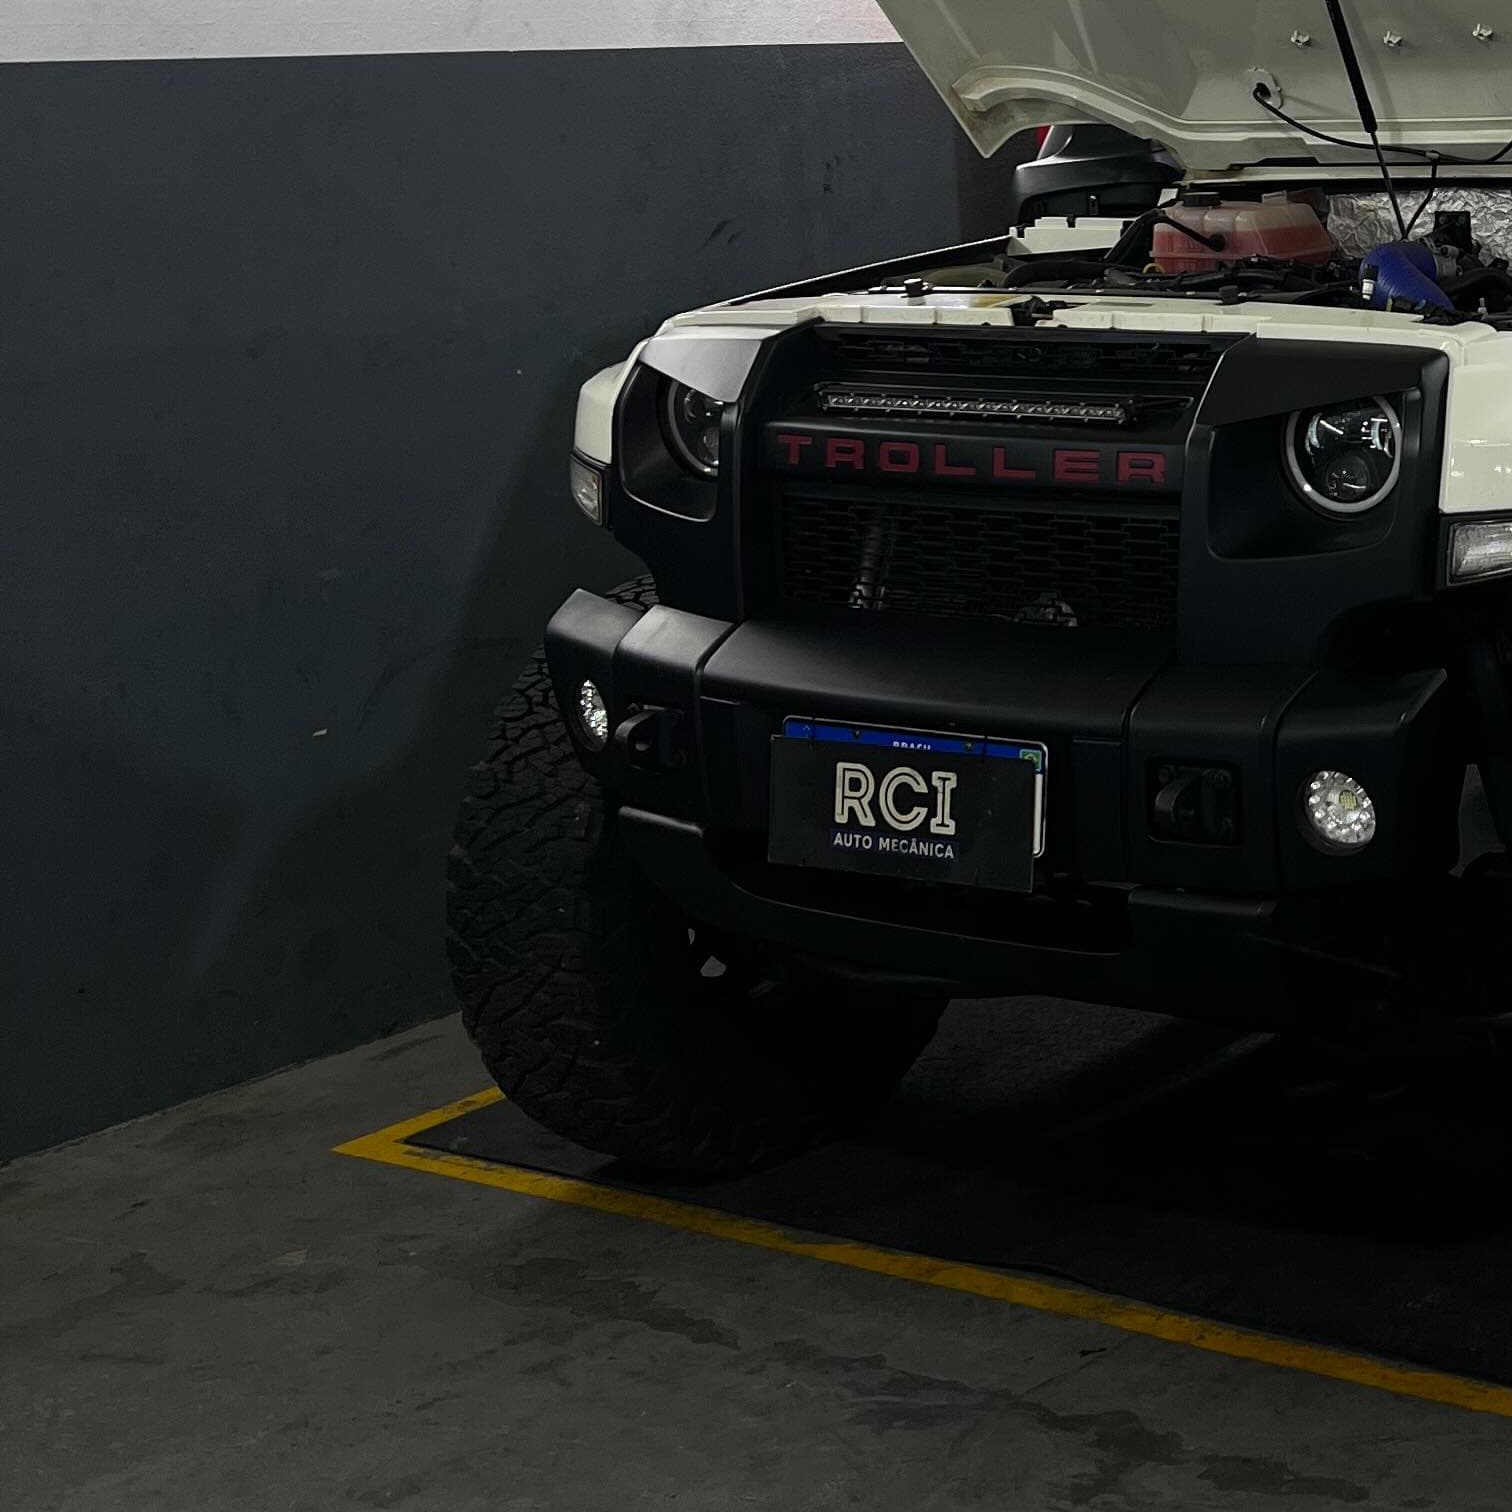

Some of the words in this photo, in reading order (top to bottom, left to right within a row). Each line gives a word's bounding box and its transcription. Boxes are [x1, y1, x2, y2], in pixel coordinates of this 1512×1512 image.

[779, 434, 1167, 483] TROLLER
[835, 761, 958, 836] RCI
[833, 833, 873, 849] AUTO
[879, 838, 954, 859] MECÂNICA
